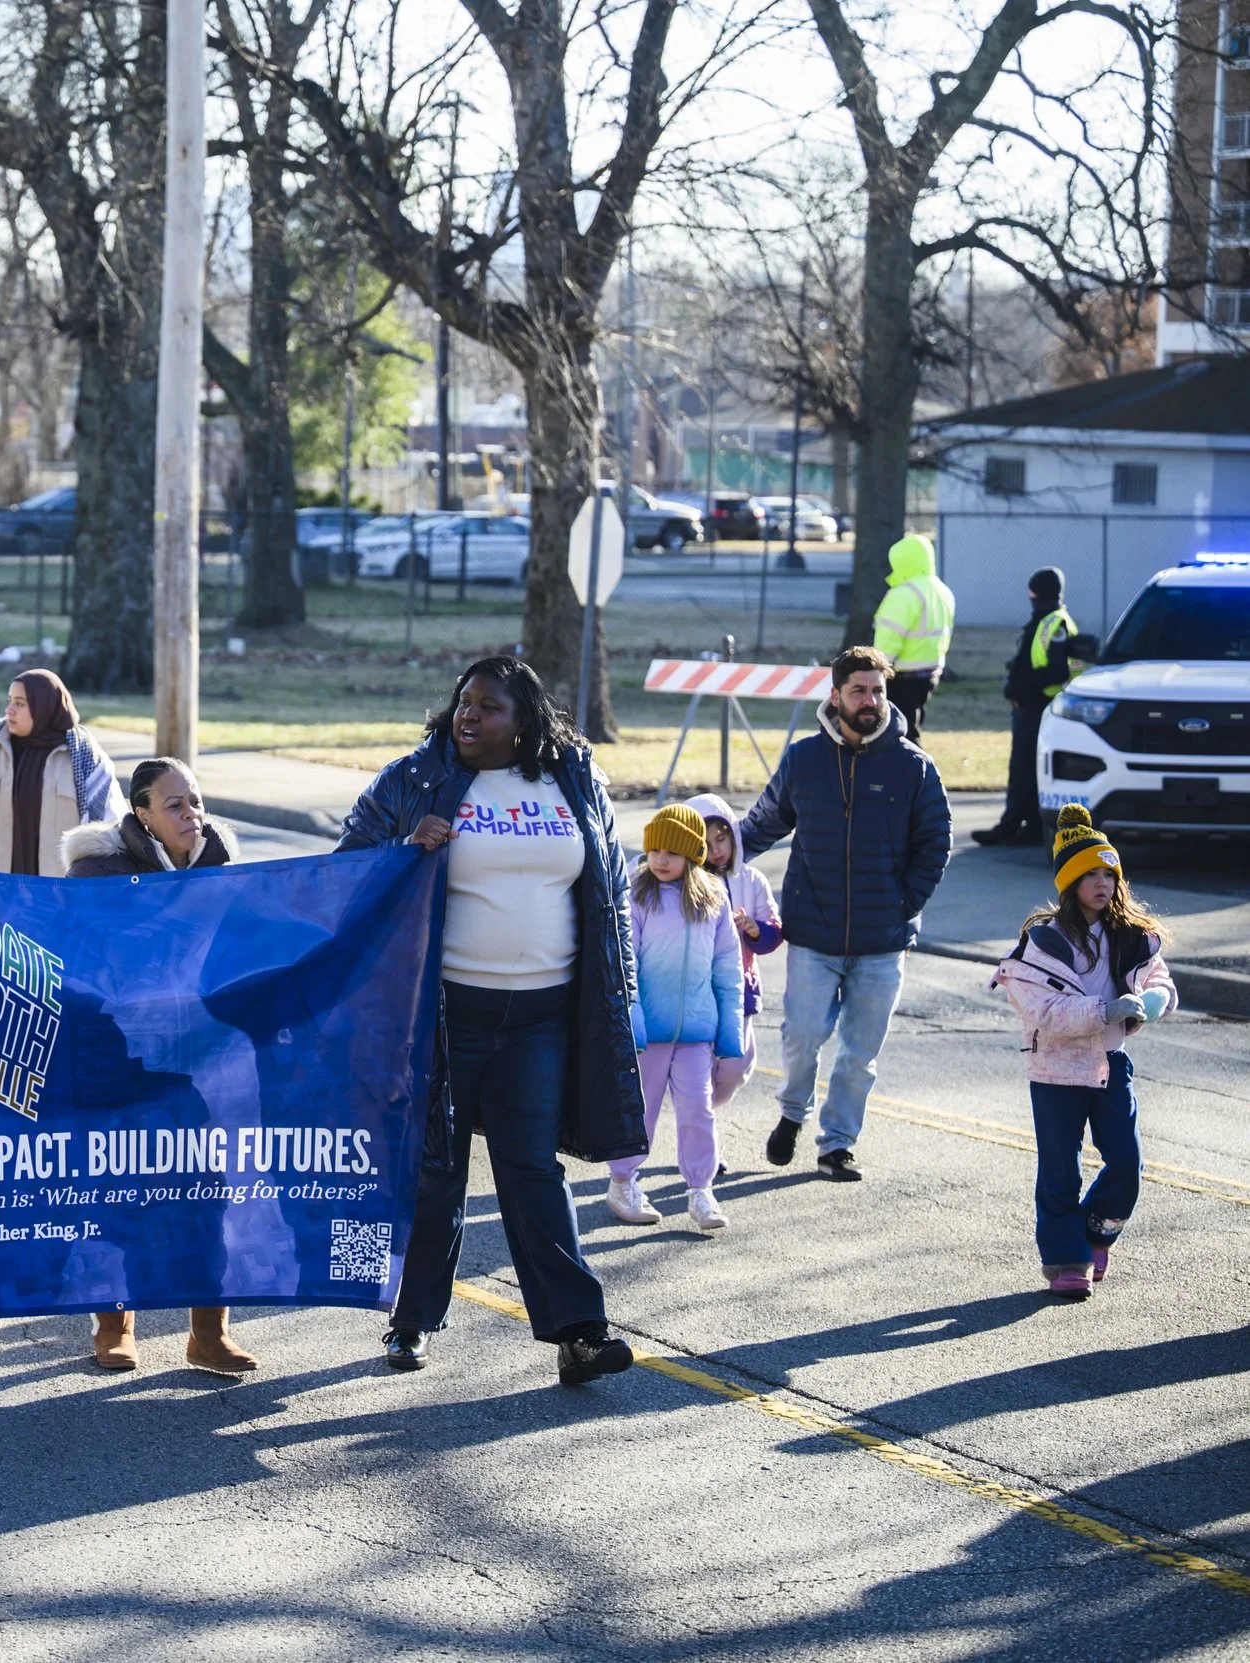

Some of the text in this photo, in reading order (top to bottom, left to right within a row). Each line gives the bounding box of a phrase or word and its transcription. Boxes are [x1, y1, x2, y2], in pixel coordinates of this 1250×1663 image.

[456, 801, 571, 822] CULTURE
[88, 1128, 227, 1176] BUILDING
[238, 1127, 379, 1175] FUTURES.
[11, 1189, 34, 1208] is:
[104, 1187, 137, 1203] are
[144, 1185, 181, 1206] you
[186, 1181, 247, 1203] doing
[249, 1180, 283, 1203] for
[33, 1221, 79, 1242] King,
[82, 1220, 102, 1238] Jr.
